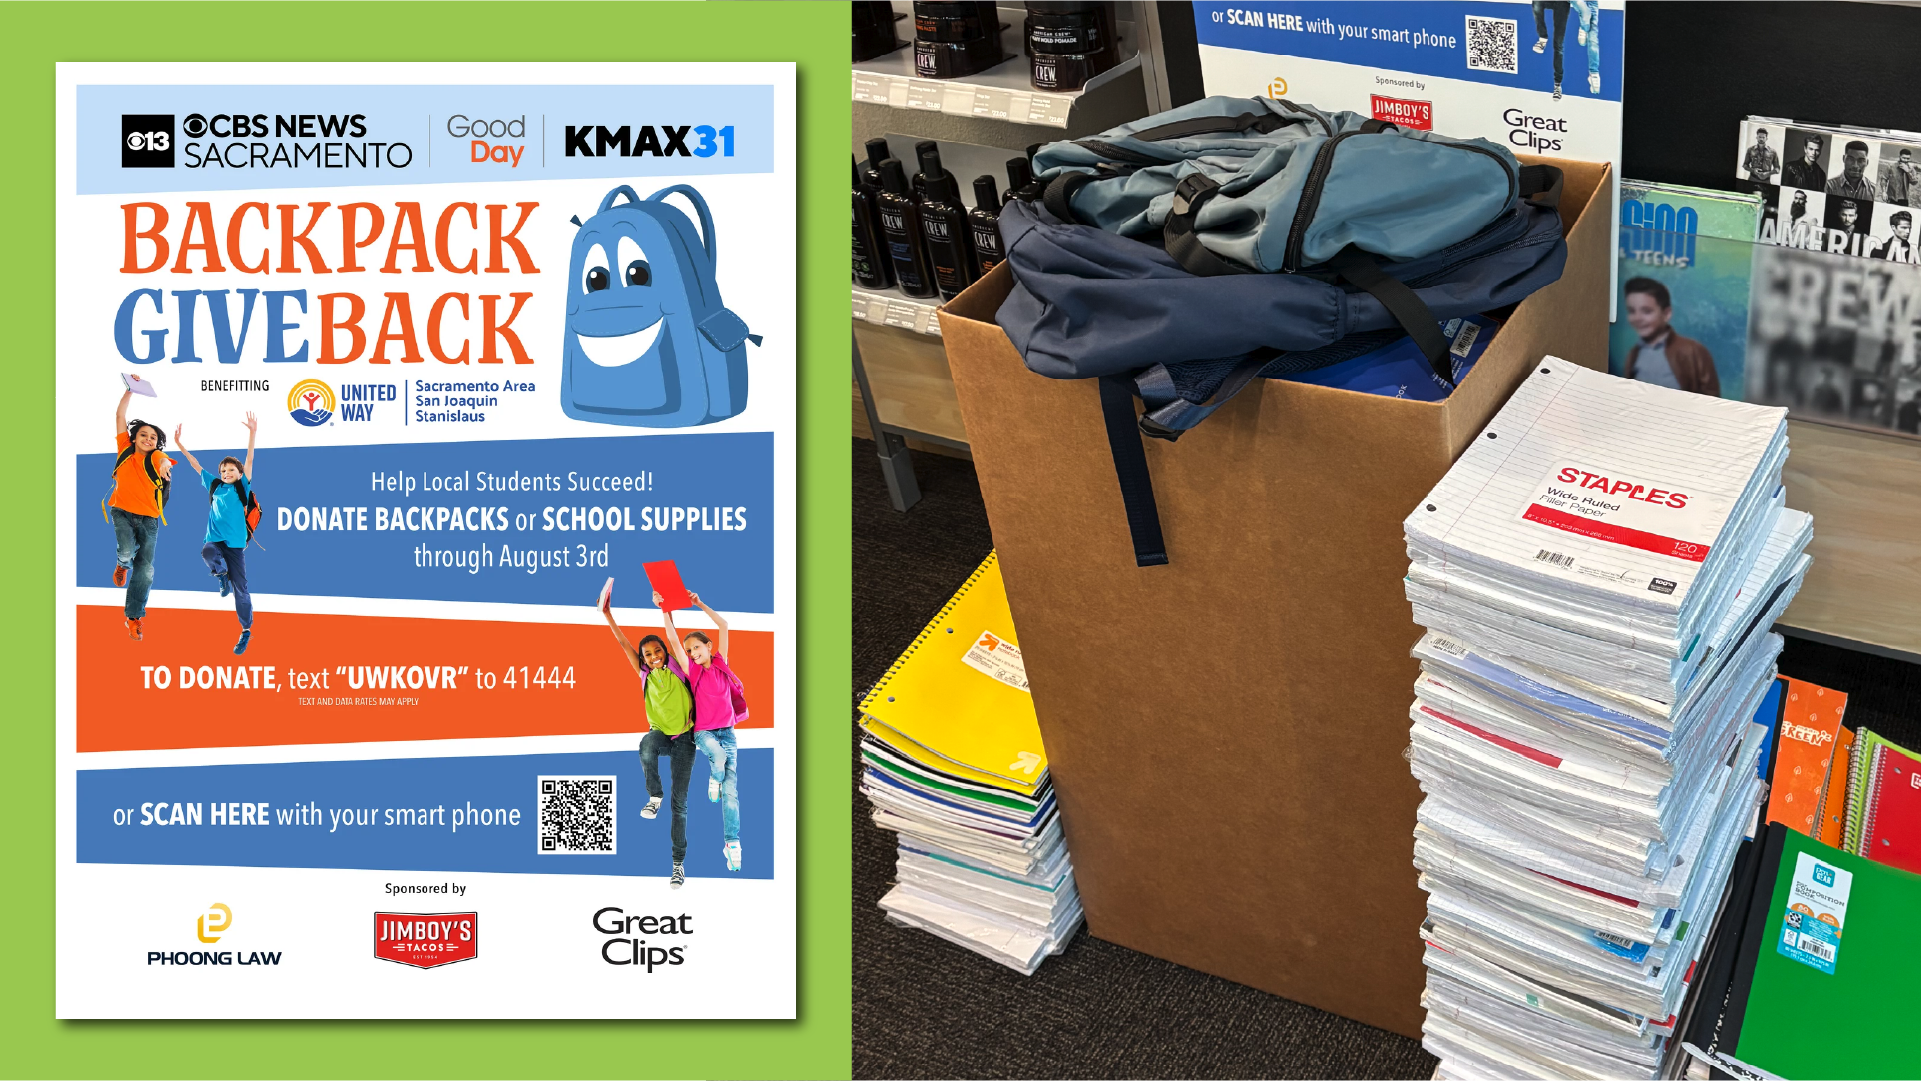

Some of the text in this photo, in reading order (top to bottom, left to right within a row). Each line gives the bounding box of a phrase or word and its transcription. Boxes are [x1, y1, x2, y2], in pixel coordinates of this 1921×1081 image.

[1212, 8, 1456, 49] or SCAN HERE with your smart phone
[1375, 76, 1426, 91] Sponsored by
[1375, 99, 1429, 120] JIMBOY'S
[1391, 116, 1414, 125] TACOS
[1503, 108, 1568, 133] Great
[146, 114, 367, 151] 13 CBS NEWS
[447, 114, 526, 138] Good
[565, 125, 735, 158] KMAX31
[1509, 129, 1562, 154] Clips
[184, 142, 412, 168] SACRAMENTO
[471, 140, 525, 168] Day
[119, 202, 541, 275] BACKPACK
[1632, 249, 1690, 269] TEENS
[114, 288, 534, 365] GIVEBACK
[201, 379, 269, 392] BENEFITTING
[341, 384, 397, 401] UNITED
[416, 380, 536, 392] Sacramento Area
[341, 404, 375, 421] WAY
[416, 394, 498, 410] San Joaquin
[416, 408, 485, 422] Stanislaus
[372, 470, 653, 493] Help Local Students Succeed!
[1557, 467, 1690, 509] STAPLES
[1539, 494, 1606, 518] Filler Paper
[1547, 487, 1621, 512] Wide Ruled
[277, 506, 747, 531] DONATE BACKPACKS or SCHOOL SUPPLIES
[414, 543, 609, 574] through August 3rd
[1674, 541, 1698, 554] 120
[1654, 579, 1675, 588] 100%
[140, 665, 172, 689] TO
[179, 665, 283, 692] DONATE,
[288, 668, 329, 689] text
[475, 668, 497, 689] to
[503, 666, 576, 689] 41444
[298, 697, 419, 705] TEXT AND DATA RATES MAY APPLY
[113, 801, 521, 833] or SCAN HERE with your smart phone
[385, 883, 466, 896] Sponsored by
[1816, 874, 1832, 885] GEAR
[1795, 888, 1814, 900] BOOK
[1796, 883, 1845, 907] COMPOSITION
[380, 920, 472, 941] JIMBOY'S
[593, 907, 693, 934] Great
[148, 951, 282, 966] PHOONG LAW
[406, 943, 444, 952] TACOS
[601, 938, 685, 973] Clips
